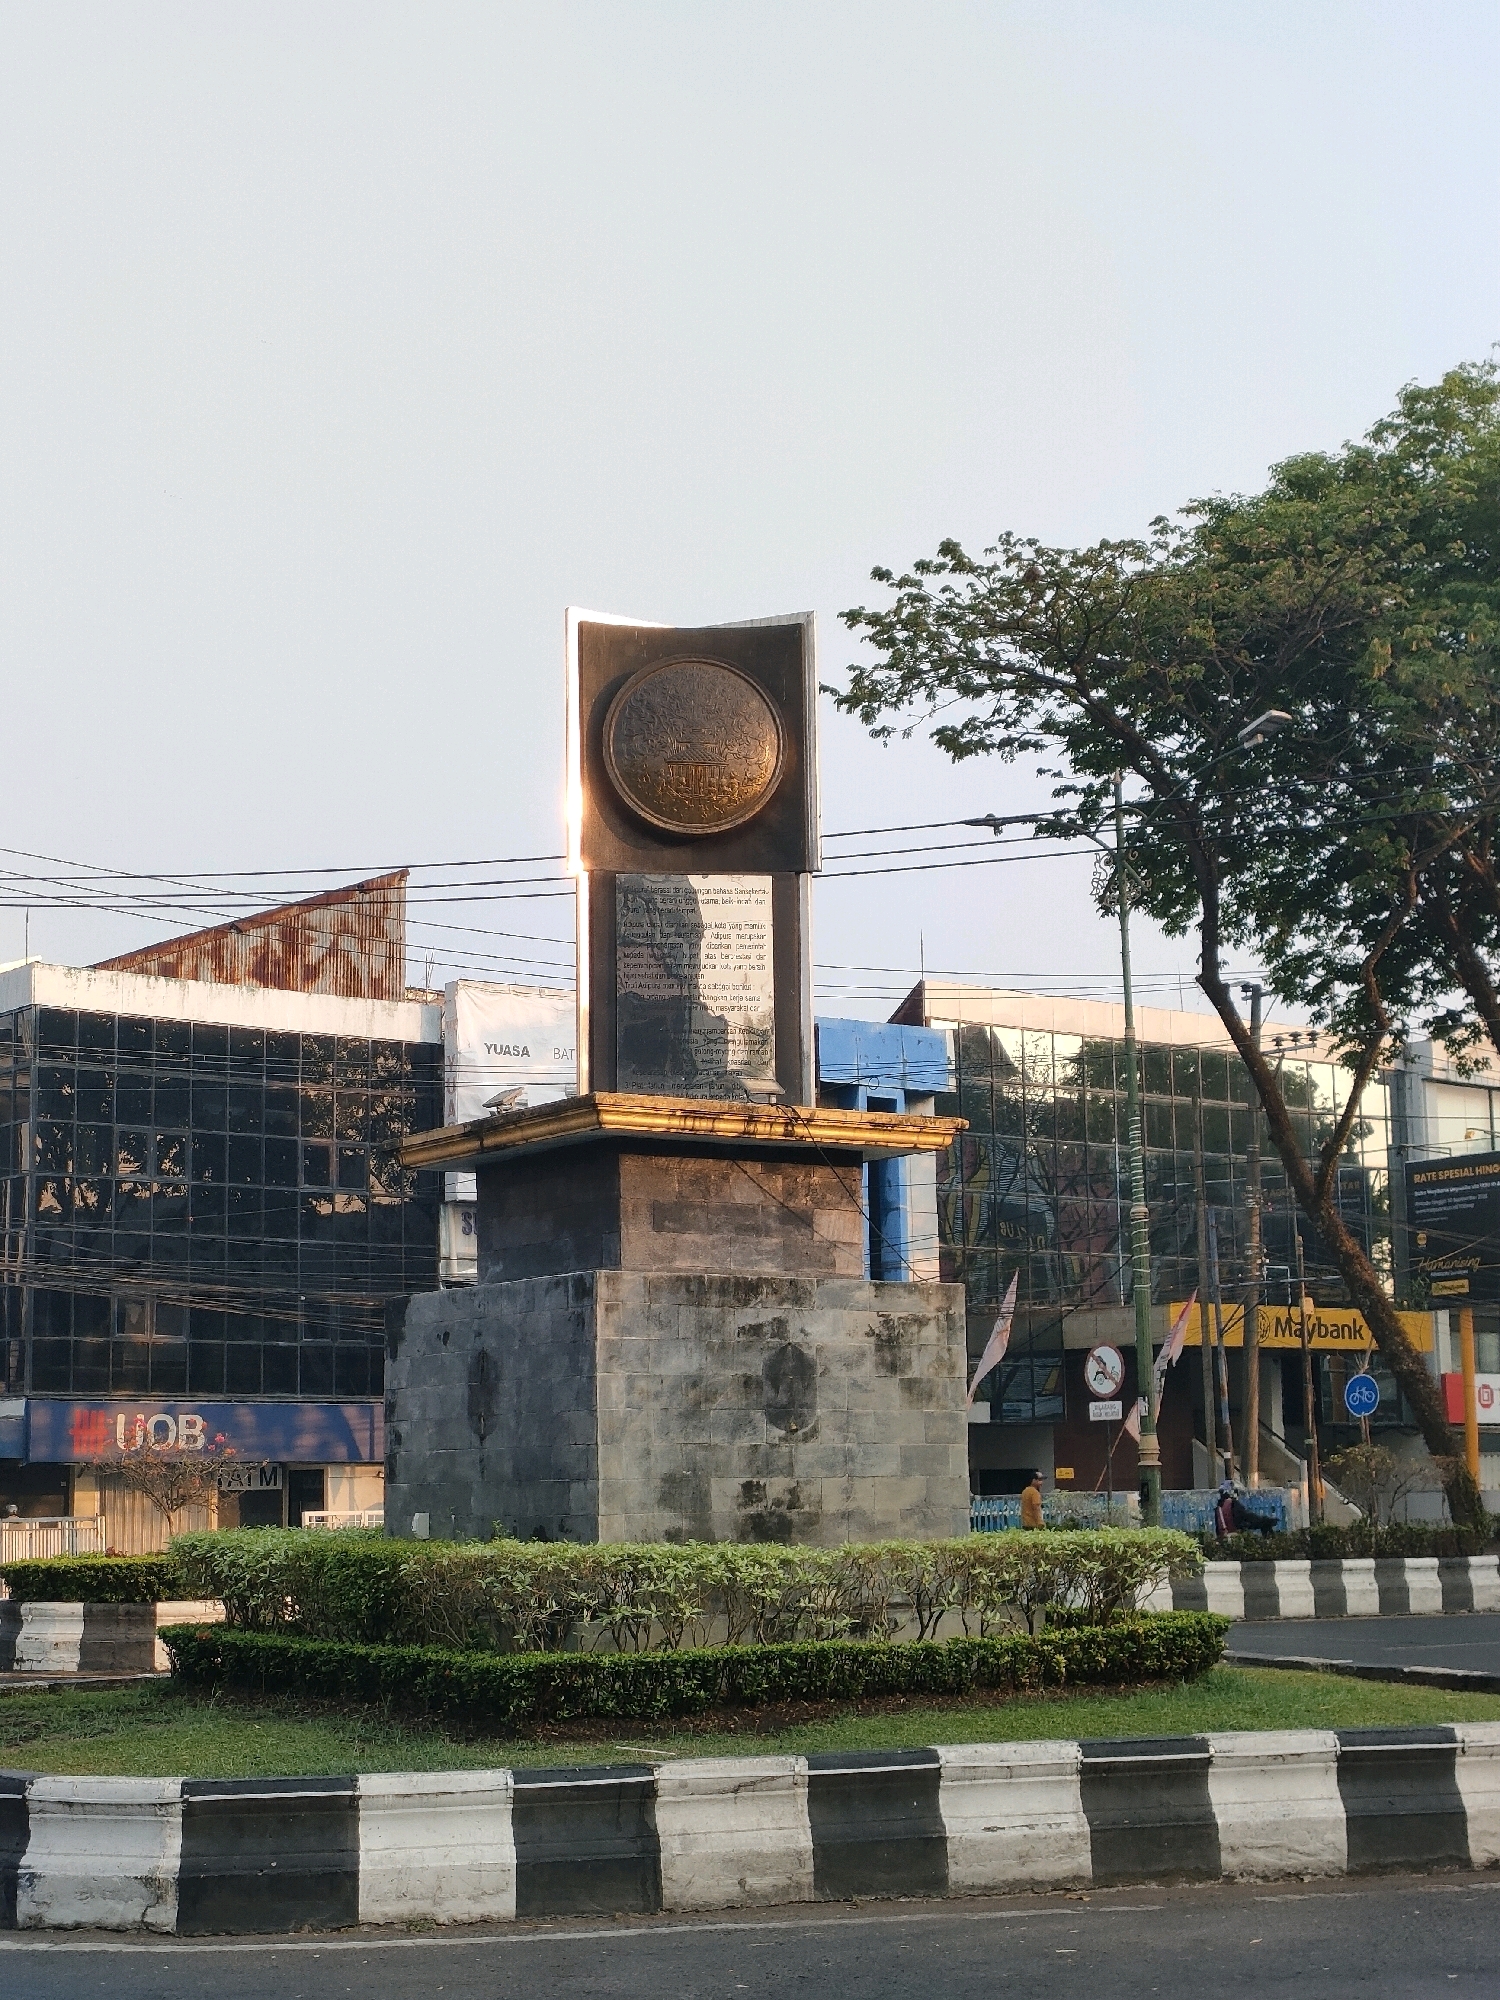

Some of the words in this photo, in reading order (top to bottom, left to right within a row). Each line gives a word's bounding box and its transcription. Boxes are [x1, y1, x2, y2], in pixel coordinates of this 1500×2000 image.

[484, 1042, 530, 1057] YUASA
[1413, 1171, 1437, 1184] RATE
[1438, 1166, 1474, 1180] SPESIAL
[1475, 1163, 1500, 1176] HING
[1274, 1315, 1364, 1344] Maybank
[116, 1413, 206, 1450] UOB
